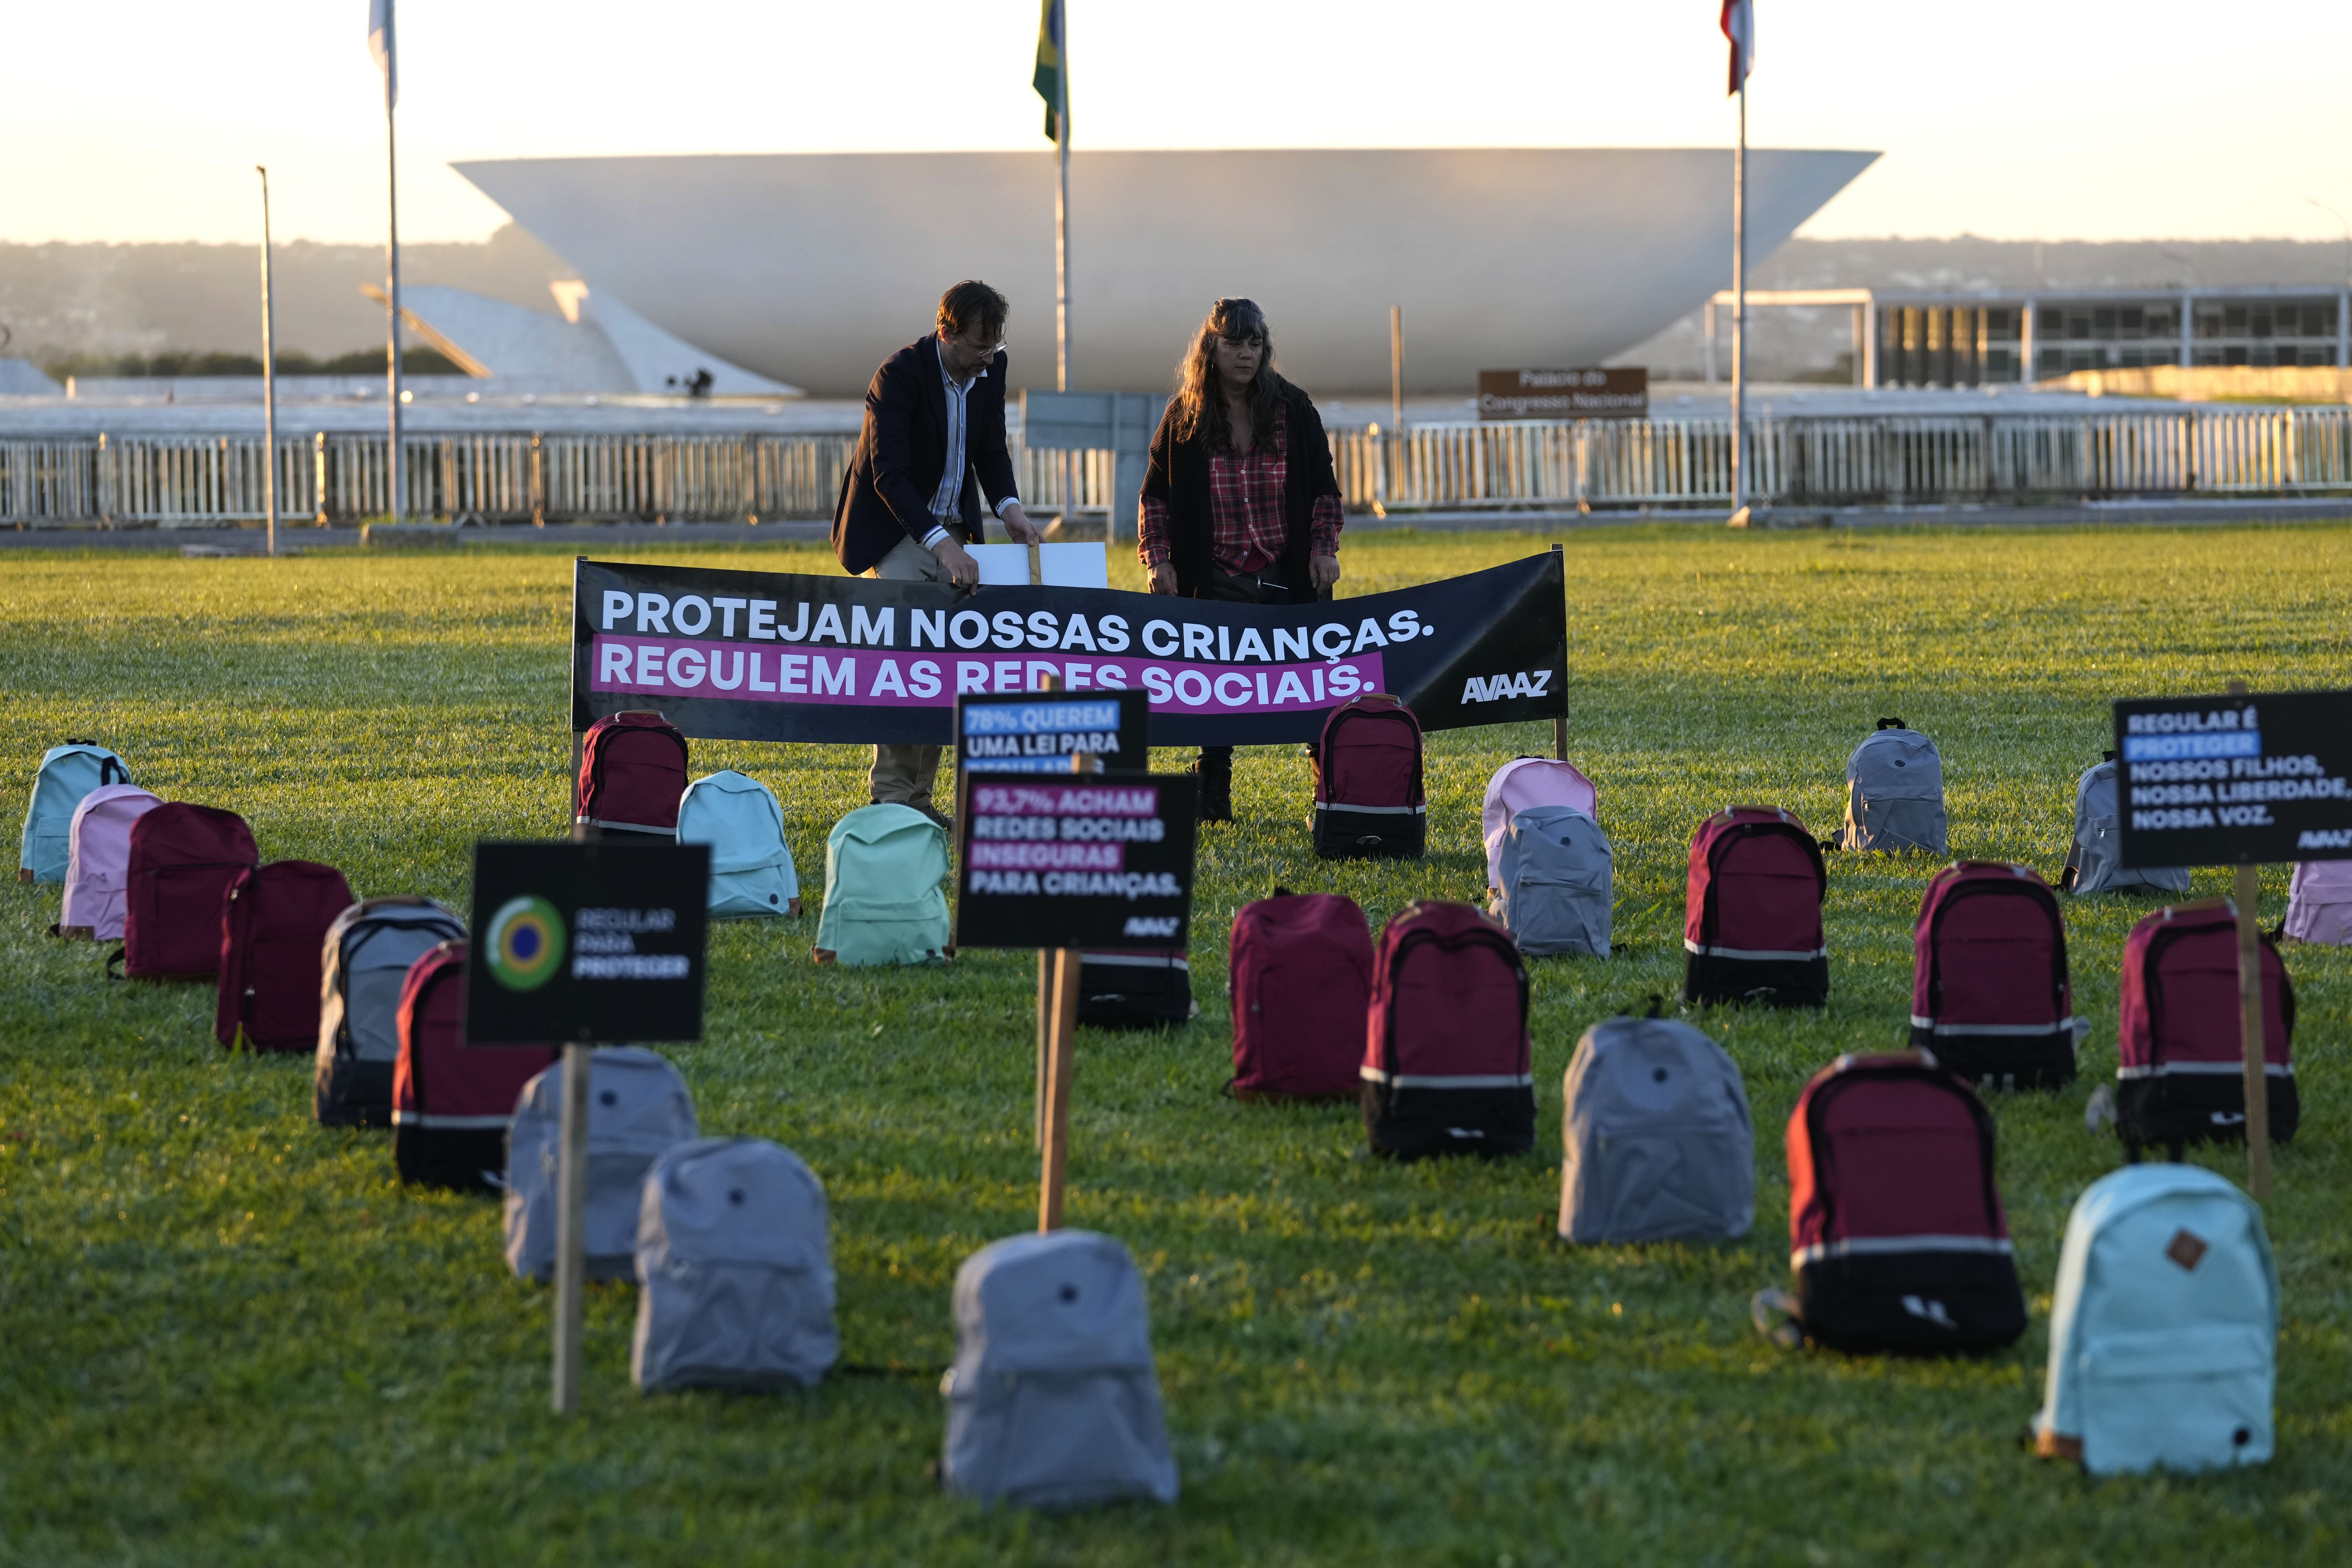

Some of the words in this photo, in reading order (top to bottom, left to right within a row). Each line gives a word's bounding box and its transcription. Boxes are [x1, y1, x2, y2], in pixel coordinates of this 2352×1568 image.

[1583, 370, 1607, 386] do
[1480, 394, 1571, 415] Congresso
[1572, 391, 1645, 408] Nacional
[603, 590, 895, 646] PROTEJAM
[911, 609, 1130, 652] NOSSAS
[1142, 610, 1434, 664] CRIANÇAS.
[600, 643, 856, 696] REGULEM
[869, 659, 942, 698] AS
[957, 661, 1127, 694] REDES
[1142, 665, 1375, 706] SOCIAIS.
[1461, 670, 1552, 704] AVAAZ
[967, 708, 1017, 731] 78%
[1021, 706, 1114, 732] QUEREM
[2128, 710, 2239, 732] REGULAR
[2242, 704, 2258, 729] É
[967, 736, 1019, 756] UMA
[1024, 735, 1056, 754] LEI
[1060, 732, 1120, 753] PARA
[2129, 735, 2254, 757] PROTEGER
[2130, 760, 2229, 782] NOSSOS
[2232, 755, 2324, 778] FILHOS,
[975, 789, 1055, 814] 93,7%
[1058, 791, 1155, 813] ACHAM
[2131, 784, 2214, 806] NOSSA
[2217, 777, 2352, 802] LIBERDADE,
[974, 817, 1057, 839] REDES
[1060, 818, 1165, 842] SOCIAIS
[2132, 807, 2215, 830] NOSSA
[2218, 805, 2275, 826] VOZ.
[971, 843, 1119, 867] INSEGURAS
[970, 872, 1040, 894] PARA
[1042, 872, 1181, 900] CRIANÇAS.
[575, 908, 676, 932] REGULAR
